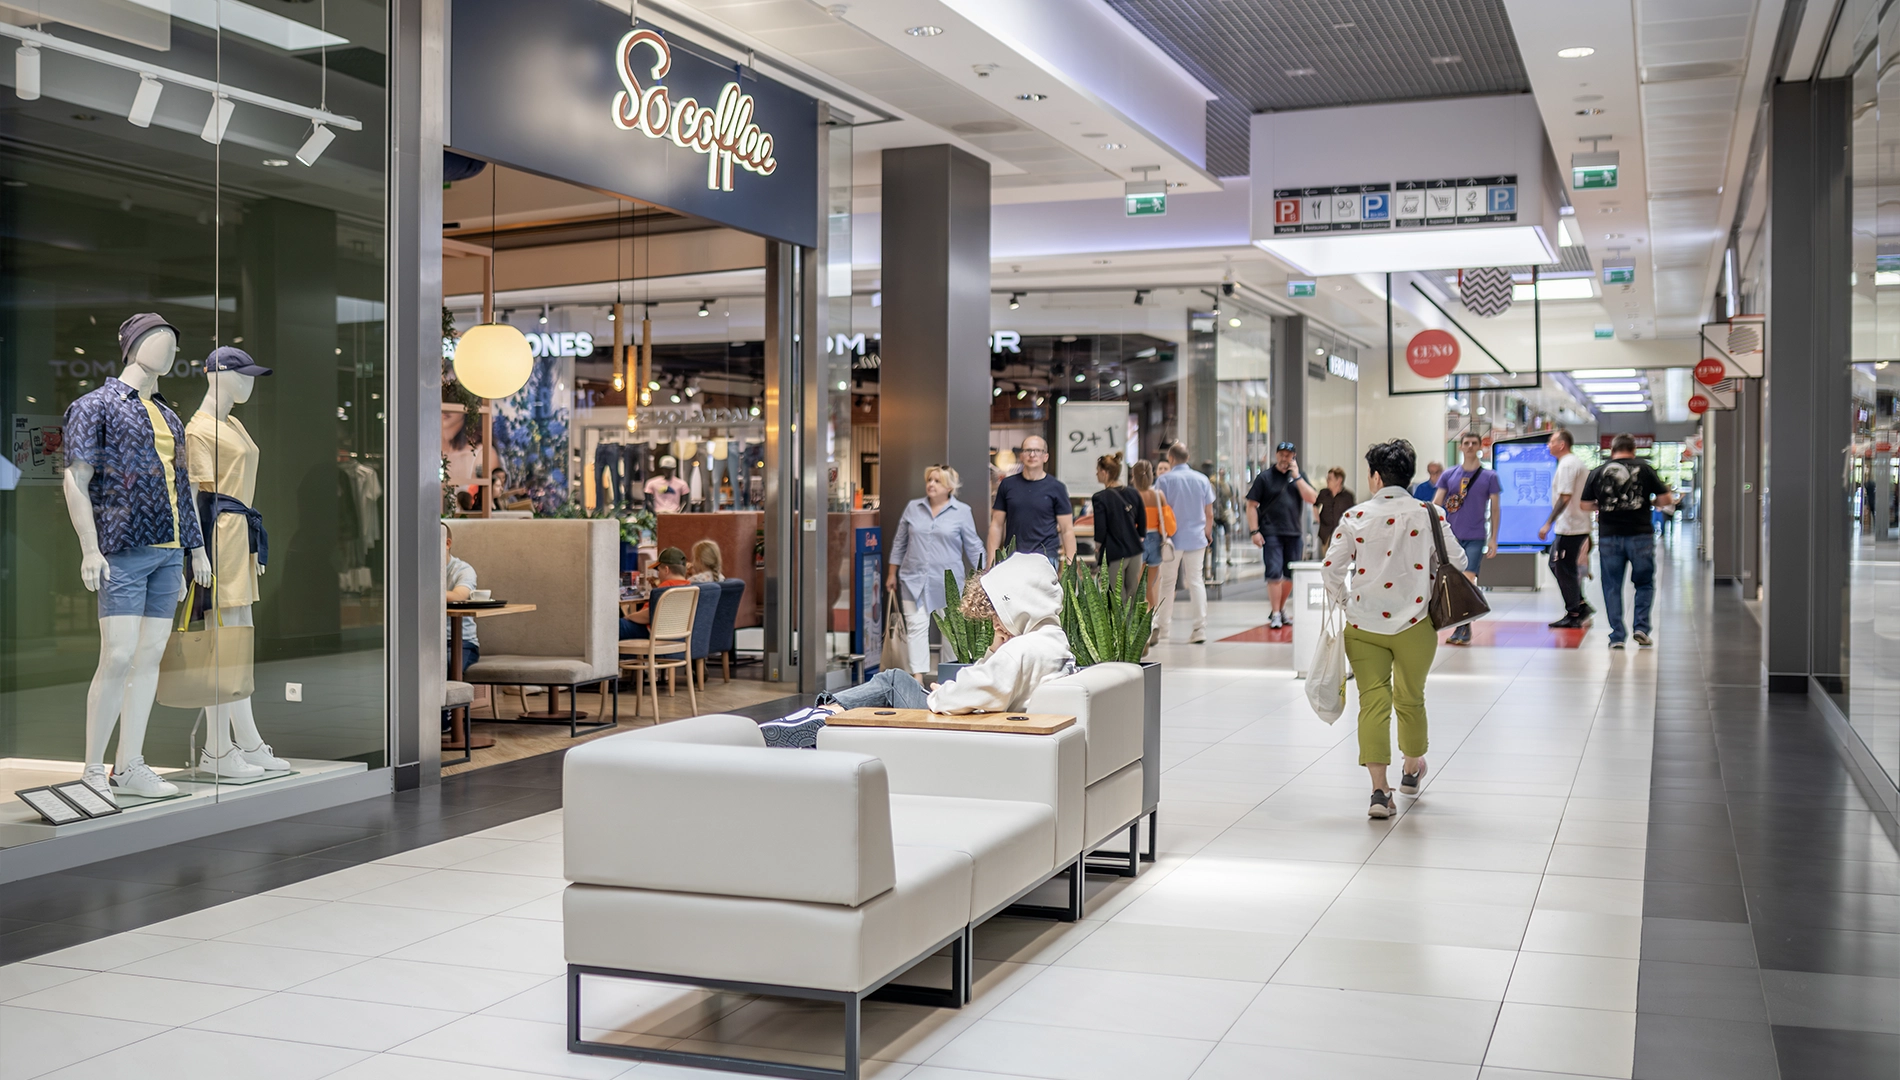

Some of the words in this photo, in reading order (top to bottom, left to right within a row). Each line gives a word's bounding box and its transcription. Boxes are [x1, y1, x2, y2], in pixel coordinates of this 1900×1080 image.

[1365, 196, 1383, 219] P
[1494, 189, 1509, 210] P
[1280, 202, 1295, 222] P
[1413, 343, 1454, 359] CENO
[48, 359, 116, 378] TOM
